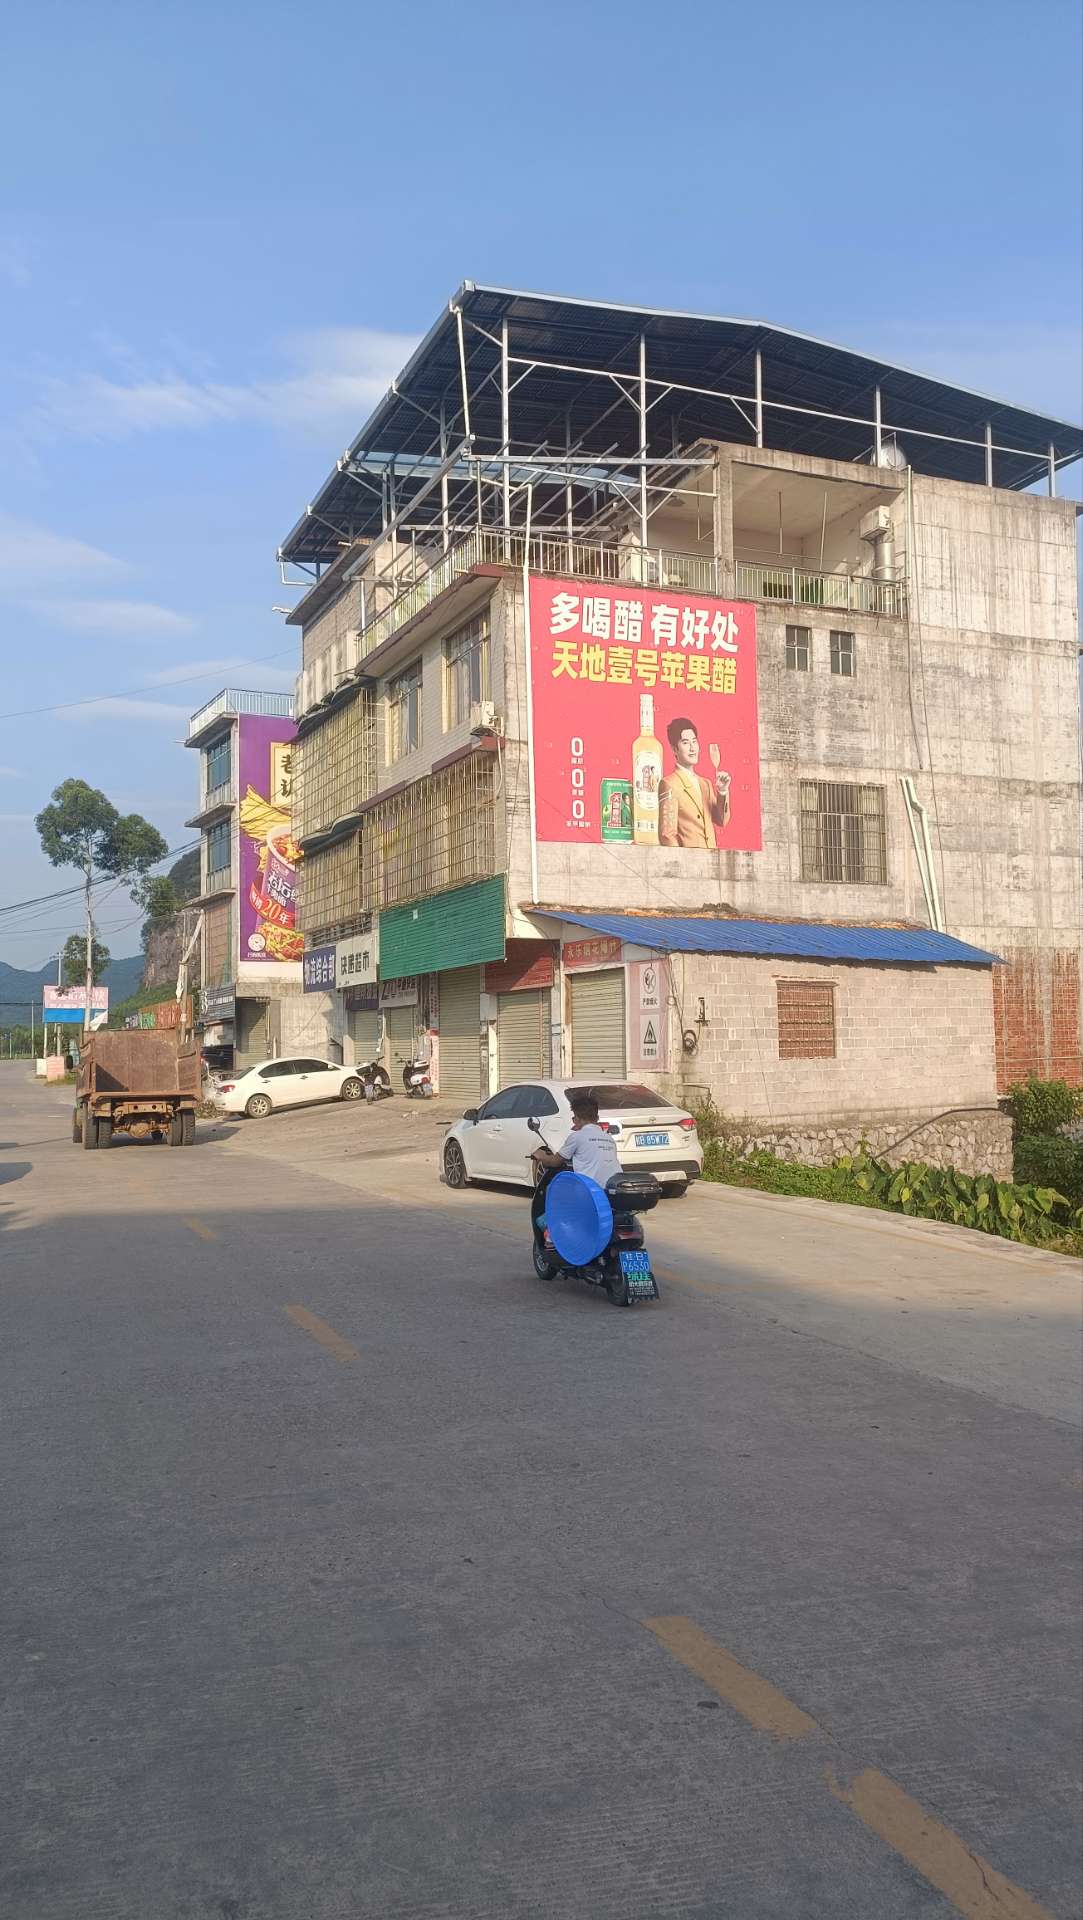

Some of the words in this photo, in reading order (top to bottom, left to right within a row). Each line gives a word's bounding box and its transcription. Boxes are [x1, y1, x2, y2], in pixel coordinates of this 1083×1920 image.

[549, 592, 644, 643] 多喝醋
[650, 604, 739, 653] 有好处
[552, 640, 737, 695] 天地壹号苹果醋
[570, 736, 584, 757] 0
[571, 768, 585, 788] 0
[572, 799, 585, 819] 0
[340, 950, 370, 976] 快递超市
